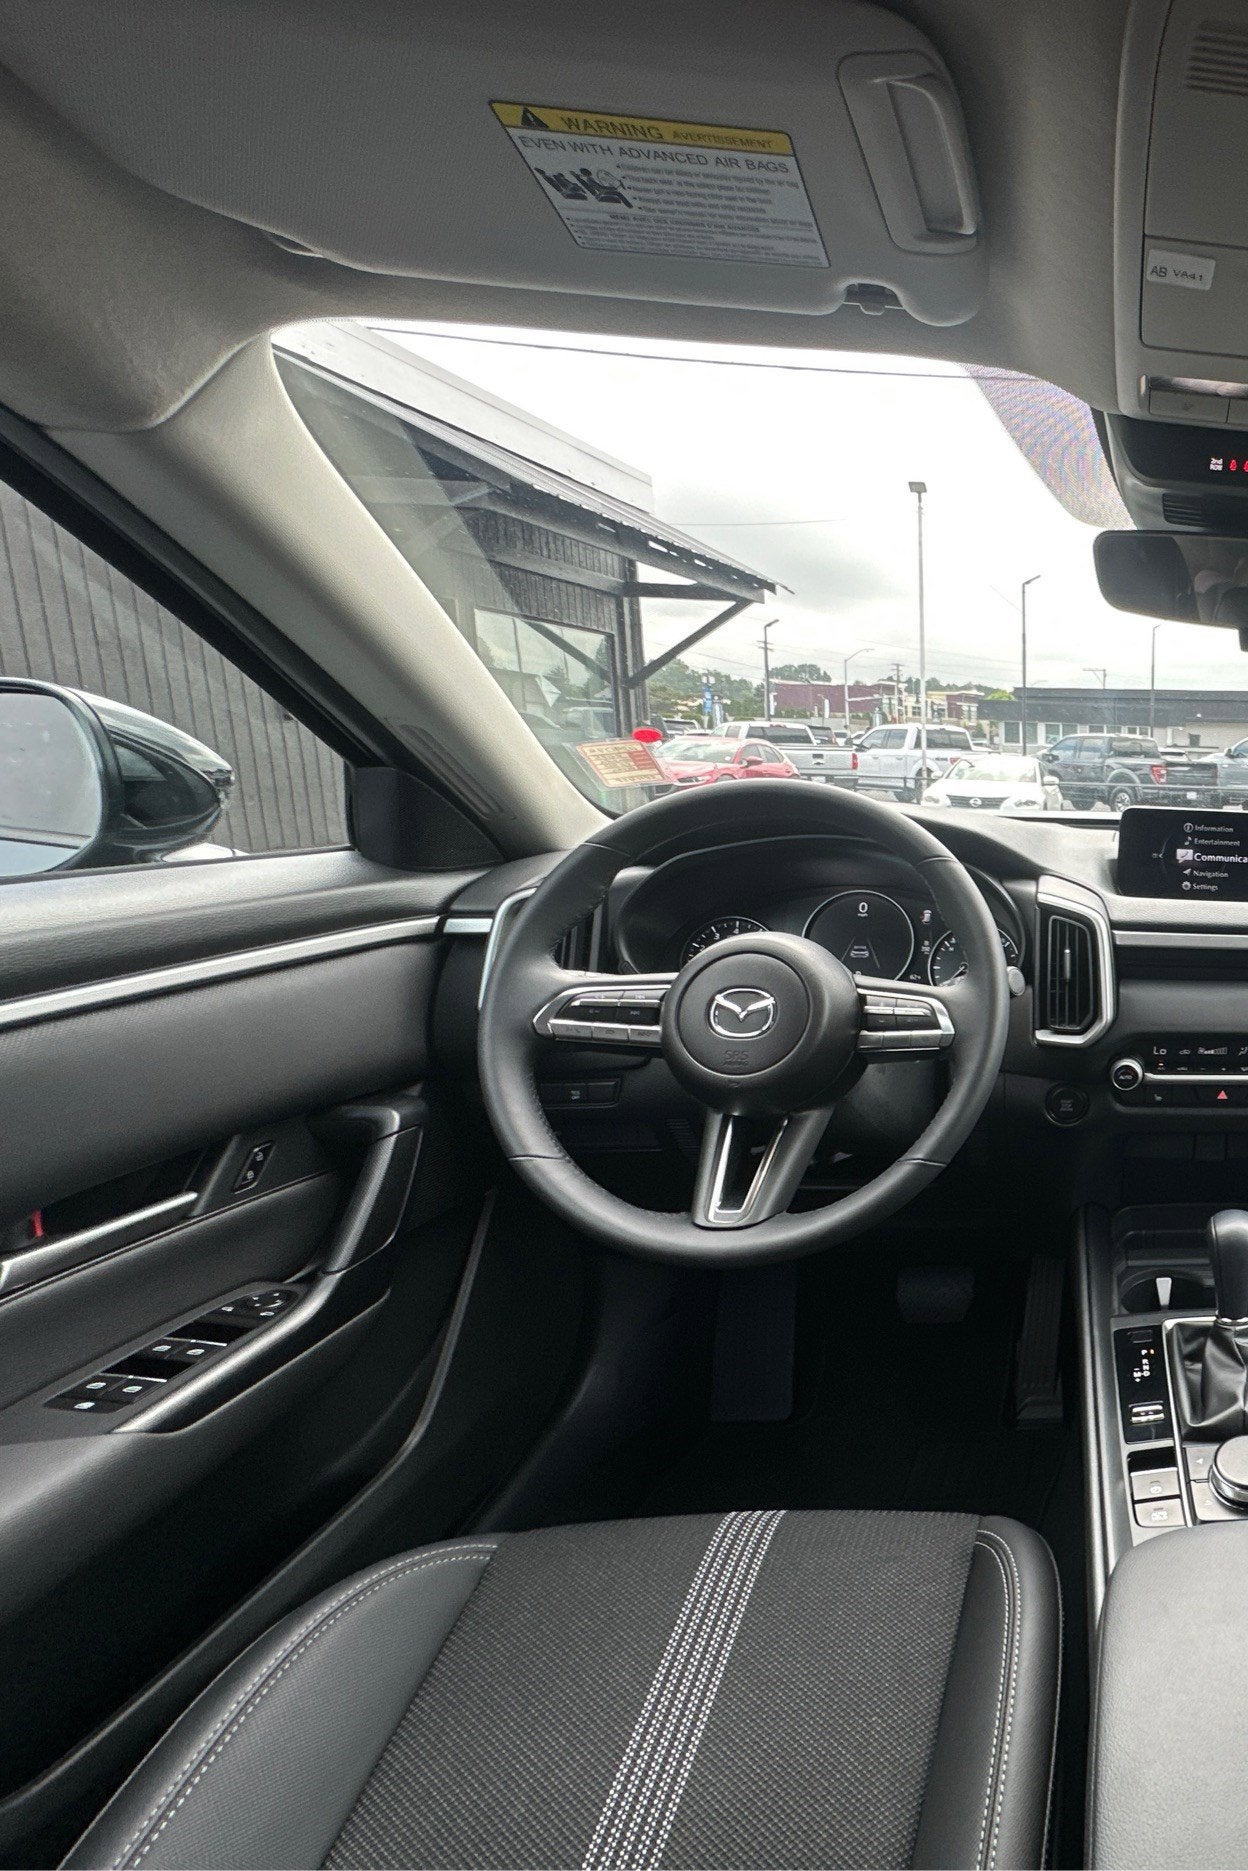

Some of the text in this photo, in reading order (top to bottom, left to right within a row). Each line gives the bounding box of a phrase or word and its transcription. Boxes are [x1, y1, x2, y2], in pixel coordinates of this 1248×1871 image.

[561, 115, 774, 149] WARNING AVERTISSEMENT
[518, 135, 790, 174] EVEN WITH ADVANCED AIR BAGS
[1150, 265, 1168, 278] AB
[1194, 823, 1234, 834] Information
[1194, 837, 1241, 848] Entertainment
[1193, 869, 1229, 880] Navigation
[1192, 882, 1219, 893] Settings
[858, 901, 869, 913] 0
[1153, 1046, 1167, 1056] Lo
